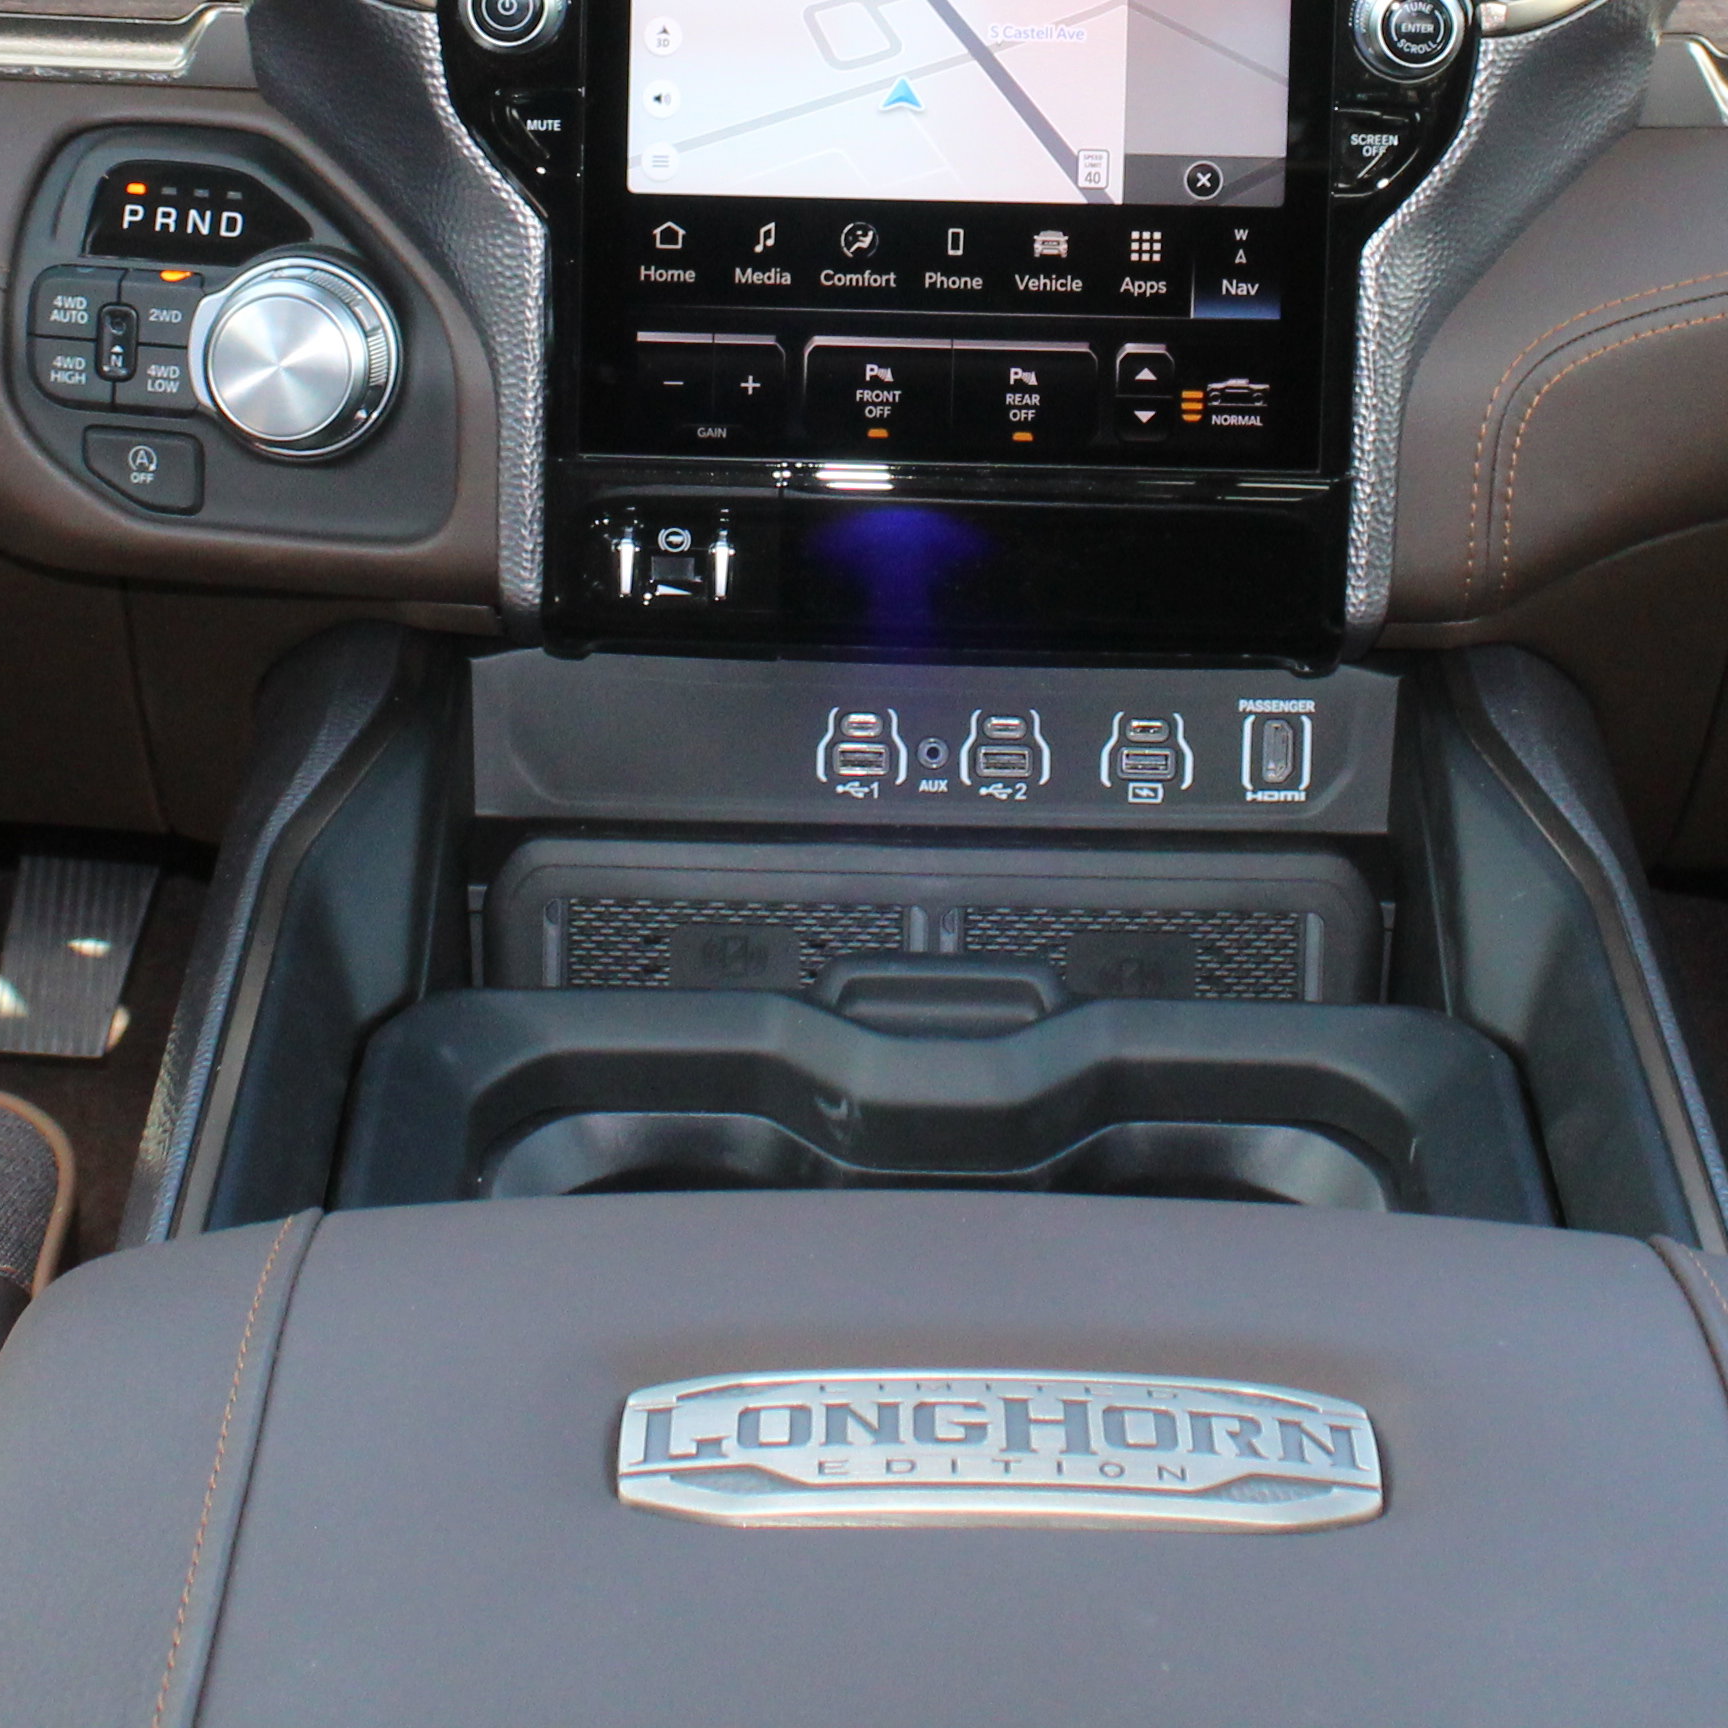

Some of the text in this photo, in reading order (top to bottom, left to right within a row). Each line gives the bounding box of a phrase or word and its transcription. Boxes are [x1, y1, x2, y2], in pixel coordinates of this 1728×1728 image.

[1404, 1, 1433, 15] TUNE
[990, 26, 1085, 40] S Castell Ave
[1401, 23, 1435, 34] ENTER
[656, 37, 670, 48] 3D
[1396, 39, 1438, 55] SCROLL
[527, 119, 562, 131] MUTE
[1350, 133, 1399, 147] SCREEN
[1362, 145, 1387, 157] OFF
[1084, 171, 1101, 184] 40
[1234, 228, 1248, 241] W
[639, 265, 696, 282] Home
[734, 267, 792, 285] Media
[820, 270, 897, 287] Comfort
[924, 272, 983, 290] Phone
[1015, 273, 1083, 292] Vehicle
[1120, 276, 1167, 297] Apps
[1222, 279, 1259, 295] Nav
[52, 295, 87, 309] 4WD
[50, 309, 88, 324] AUTO
[149, 309, 182, 323] 2WD
[52, 356, 86, 370] 4WD
[110, 355, 122, 367] N
[50, 371, 87, 385] HIGH
[147, 365, 180, 379] 4WD
[147, 379, 180, 392] LOW
[856, 389, 902, 403] FRONT
[1005, 393, 1040, 406] REAR
[864, 405, 892, 418] OFF
[1009, 409, 1036, 421] OFF
[1211, 414, 1263, 426] NORMAL
[697, 427, 727, 439] GAIN
[130, 472, 154, 484] OFF
[1238, 698, 1316, 713] PASSENGER
[870, 781, 879, 799] 1
[918, 779, 949, 793] AUX
[1014, 783, 1028, 800] 2
[637, 1395, 1372, 1472] LONGHORN
[817, 1458, 1191, 1480] EDITION
